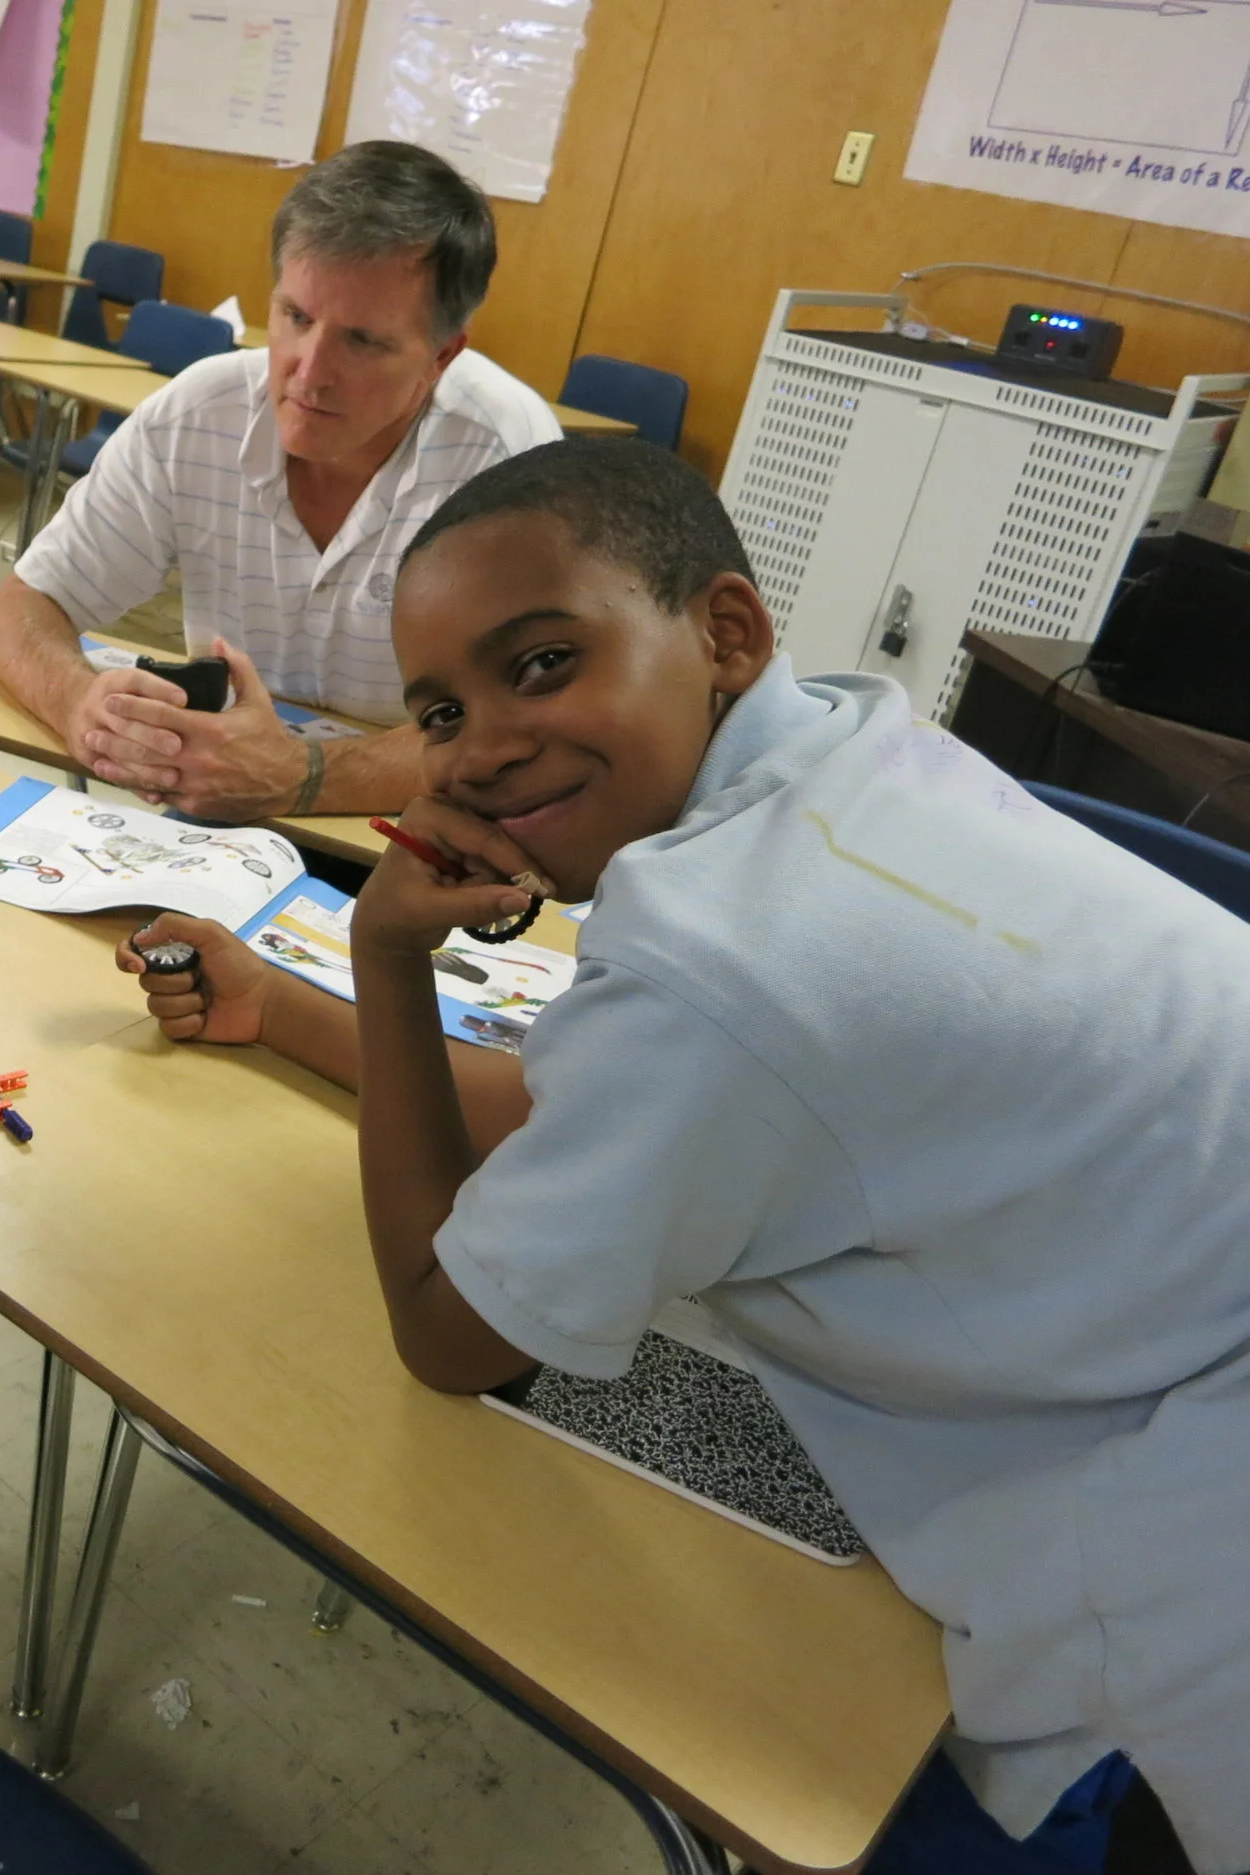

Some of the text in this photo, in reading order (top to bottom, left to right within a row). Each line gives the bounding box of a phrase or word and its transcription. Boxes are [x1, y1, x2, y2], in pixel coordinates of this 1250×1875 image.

[969, 135, 1026, 162] Width
[1030, 149, 1042, 165] x
[1045, 144, 1107, 174] Height
[1112, 158, 1122, 168] =
[1125, 154, 1175, 182] Area
[1180, 162, 1207, 186] of
[1206, 171, 1220, 188] a
